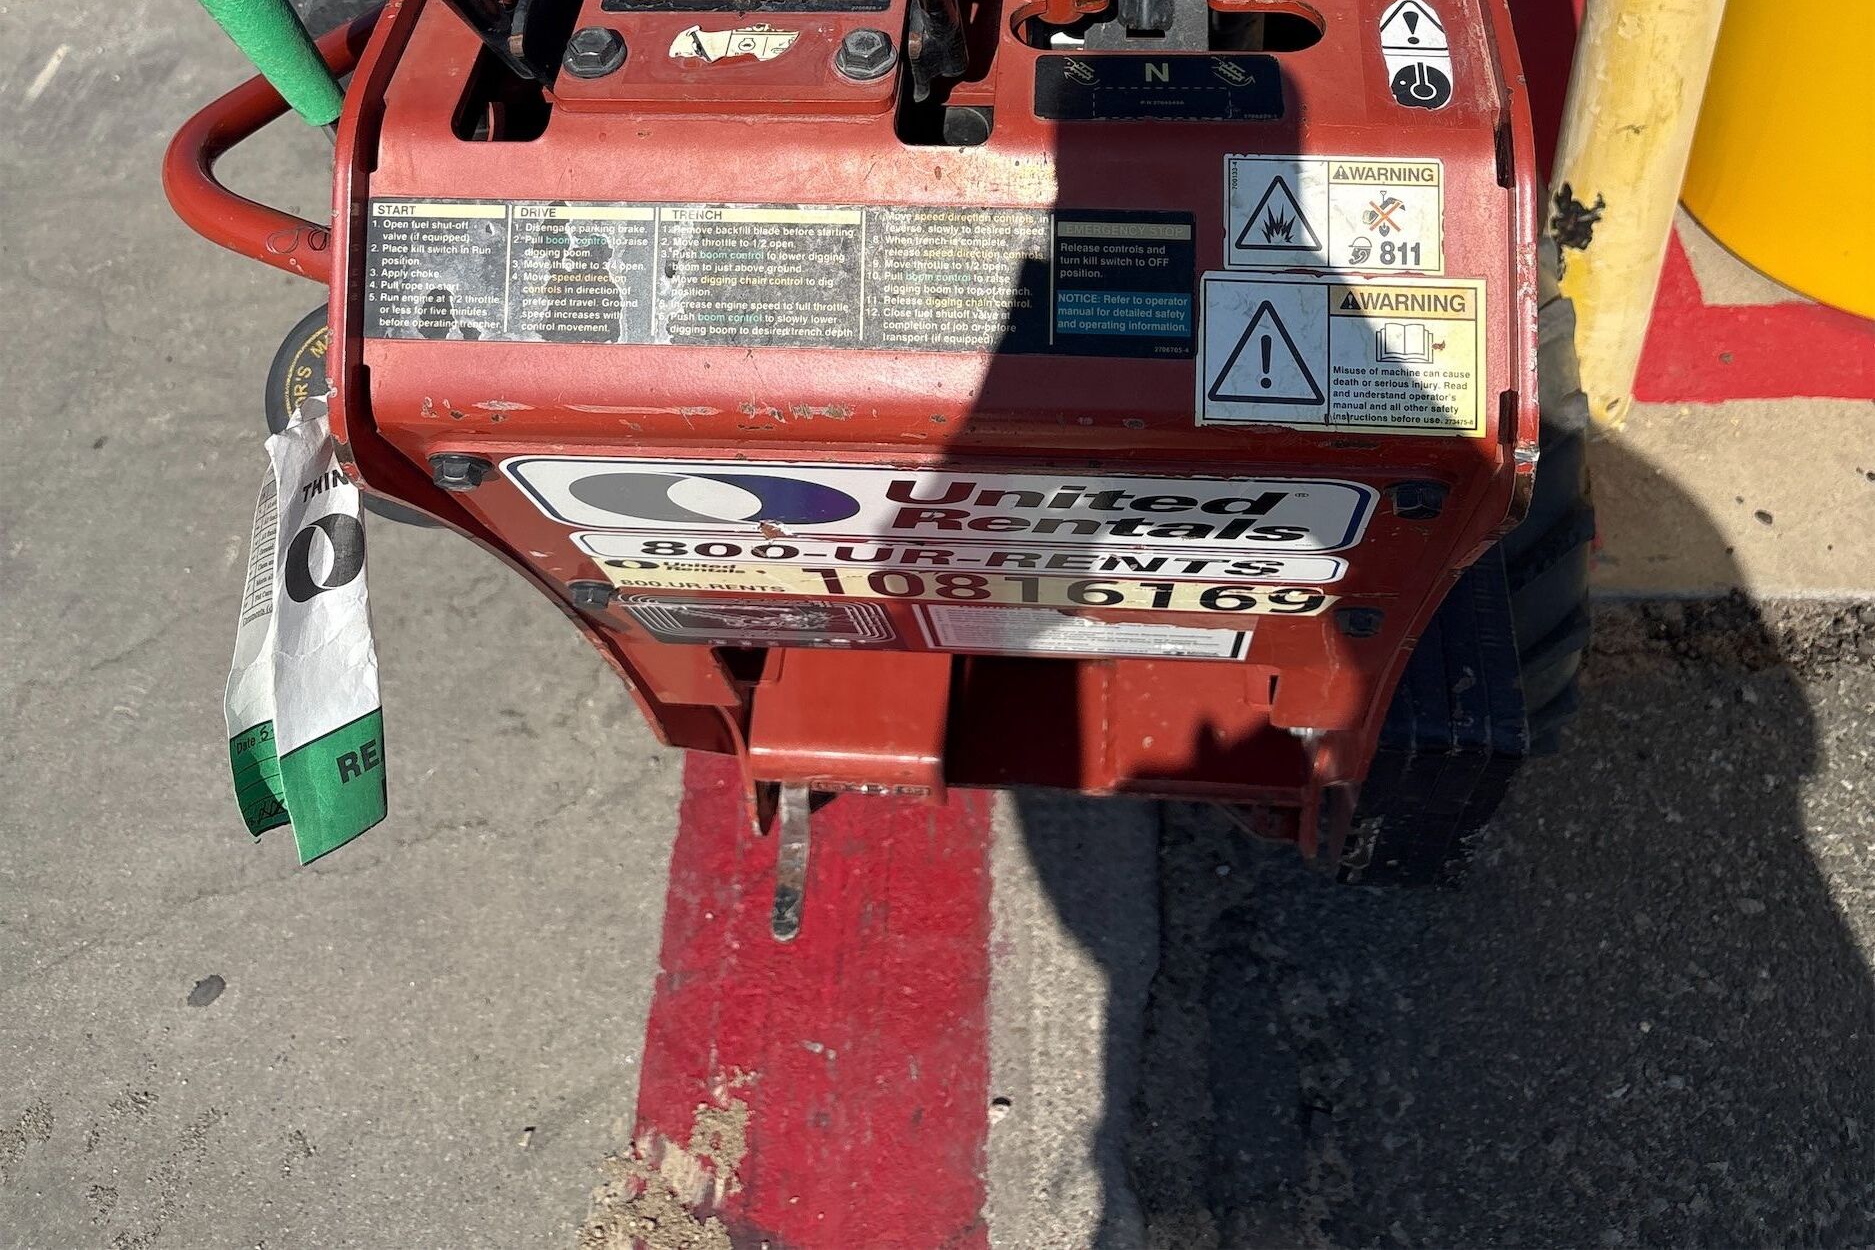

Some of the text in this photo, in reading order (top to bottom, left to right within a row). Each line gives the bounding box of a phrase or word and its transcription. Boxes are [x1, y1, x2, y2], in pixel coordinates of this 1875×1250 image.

[1145, 63, 1170, 83] N
[1349, 166, 1434, 182] WARNING
[378, 205, 416, 215] START
[520, 208, 557, 217] DRIVE
[672, 210, 723, 220] TRENCH
[383, 220, 409, 231] Open
[411, 220, 429, 229] fuel
[431, 221, 469, 230] shut-off
[525, 223, 576, 234] Disengage
[578, 224, 615, 235] parking
[617, 225, 648, 234] brake.
[1066, 225, 1186, 237] EMERGENCY STOP
[382, 233, 408, 241] valve
[410, 233, 420, 243] (if
[672, 238, 700, 247] Move
[701, 238, 737, 248] throttle
[739, 239, 750, 248] to
[752, 239, 768, 249] 1/2
[382, 244, 408, 253] Place
[411, 245, 425, 253] kill
[427, 245, 458, 254] switch
[460, 245, 470, 254] in
[472, 246, 492, 255] Run
[524, 247, 560, 258] digging
[1060, 243, 1166, 255] Release controls and
[1379, 240, 1421, 265] 811
[381, 255, 422, 267] position.
[523, 260, 550, 269] Move
[590, 261, 600, 270] to
[1060, 257, 1169, 267] turn kill switch to OFF
[381, 269, 408, 280] Apply
[411, 270, 442, 278] choke.
[523, 273, 550, 282] Move
[1060, 268, 1103, 279] position.
[380, 281, 399, 290] Pull
[401, 282, 423, 292] rope
[425, 282, 435, 291] to
[522, 286, 632, 296] controls in direction of
[380, 293, 399, 302] Run
[401, 294, 434, 305] engine
[436, 294, 446, 303] at
[465, 295, 500, 304] throttle
[522, 298, 638, 308] preferred travel. Ground
[1058, 294, 1188, 307] NOTICE: Refer to operator
[1360, 292, 1466, 313] WARNING
[379, 306, 390, 314] or
[392, 305, 411, 315] less
[414, 306, 427, 315] for
[430, 306, 447, 315] five
[522, 310, 622, 321] speed increases with
[1058, 307, 1185, 320] manual for detailed safety
[379, 318, 410, 327] before
[412, 319, 457, 329] operating
[521, 322, 555, 331] control
[1058, 320, 1187, 332] and operating information.
[670, 325, 706, 336] digging
[709, 326, 737, 335] boom
[739, 326, 750, 335] to
[752, 326, 788, 336] desired
[791, 327, 825, 337] trench
[883, 332, 929, 343] transport
[1333, 366, 1366, 375] Misuse
[1369, 366, 1378, 375] of
[1381, 367, 1420, 377] machine
[1423, 370, 1440, 378] can
[1333, 377, 1359, 387] death
[1375, 379, 1409, 388] serious
[1412, 380, 1441, 391] injury.
[1444, 382, 1468, 390] Read
[1333, 390, 1456, 402] and understand operator's
[1333, 402, 1459, 415] manual and all other safety
[1333, 412, 1443, 424] instructions before use.
[886, 480, 1290, 516] United
[892, 507, 1310, 541] Rentals
[641, 540, 1285, 576] 800-UR-RENTS
[663, 561, 737, 569] United
[665, 566, 746, 575] Rentals
[802, 568, 1326, 613] 10816169
[236, 736, 256, 755] Date
